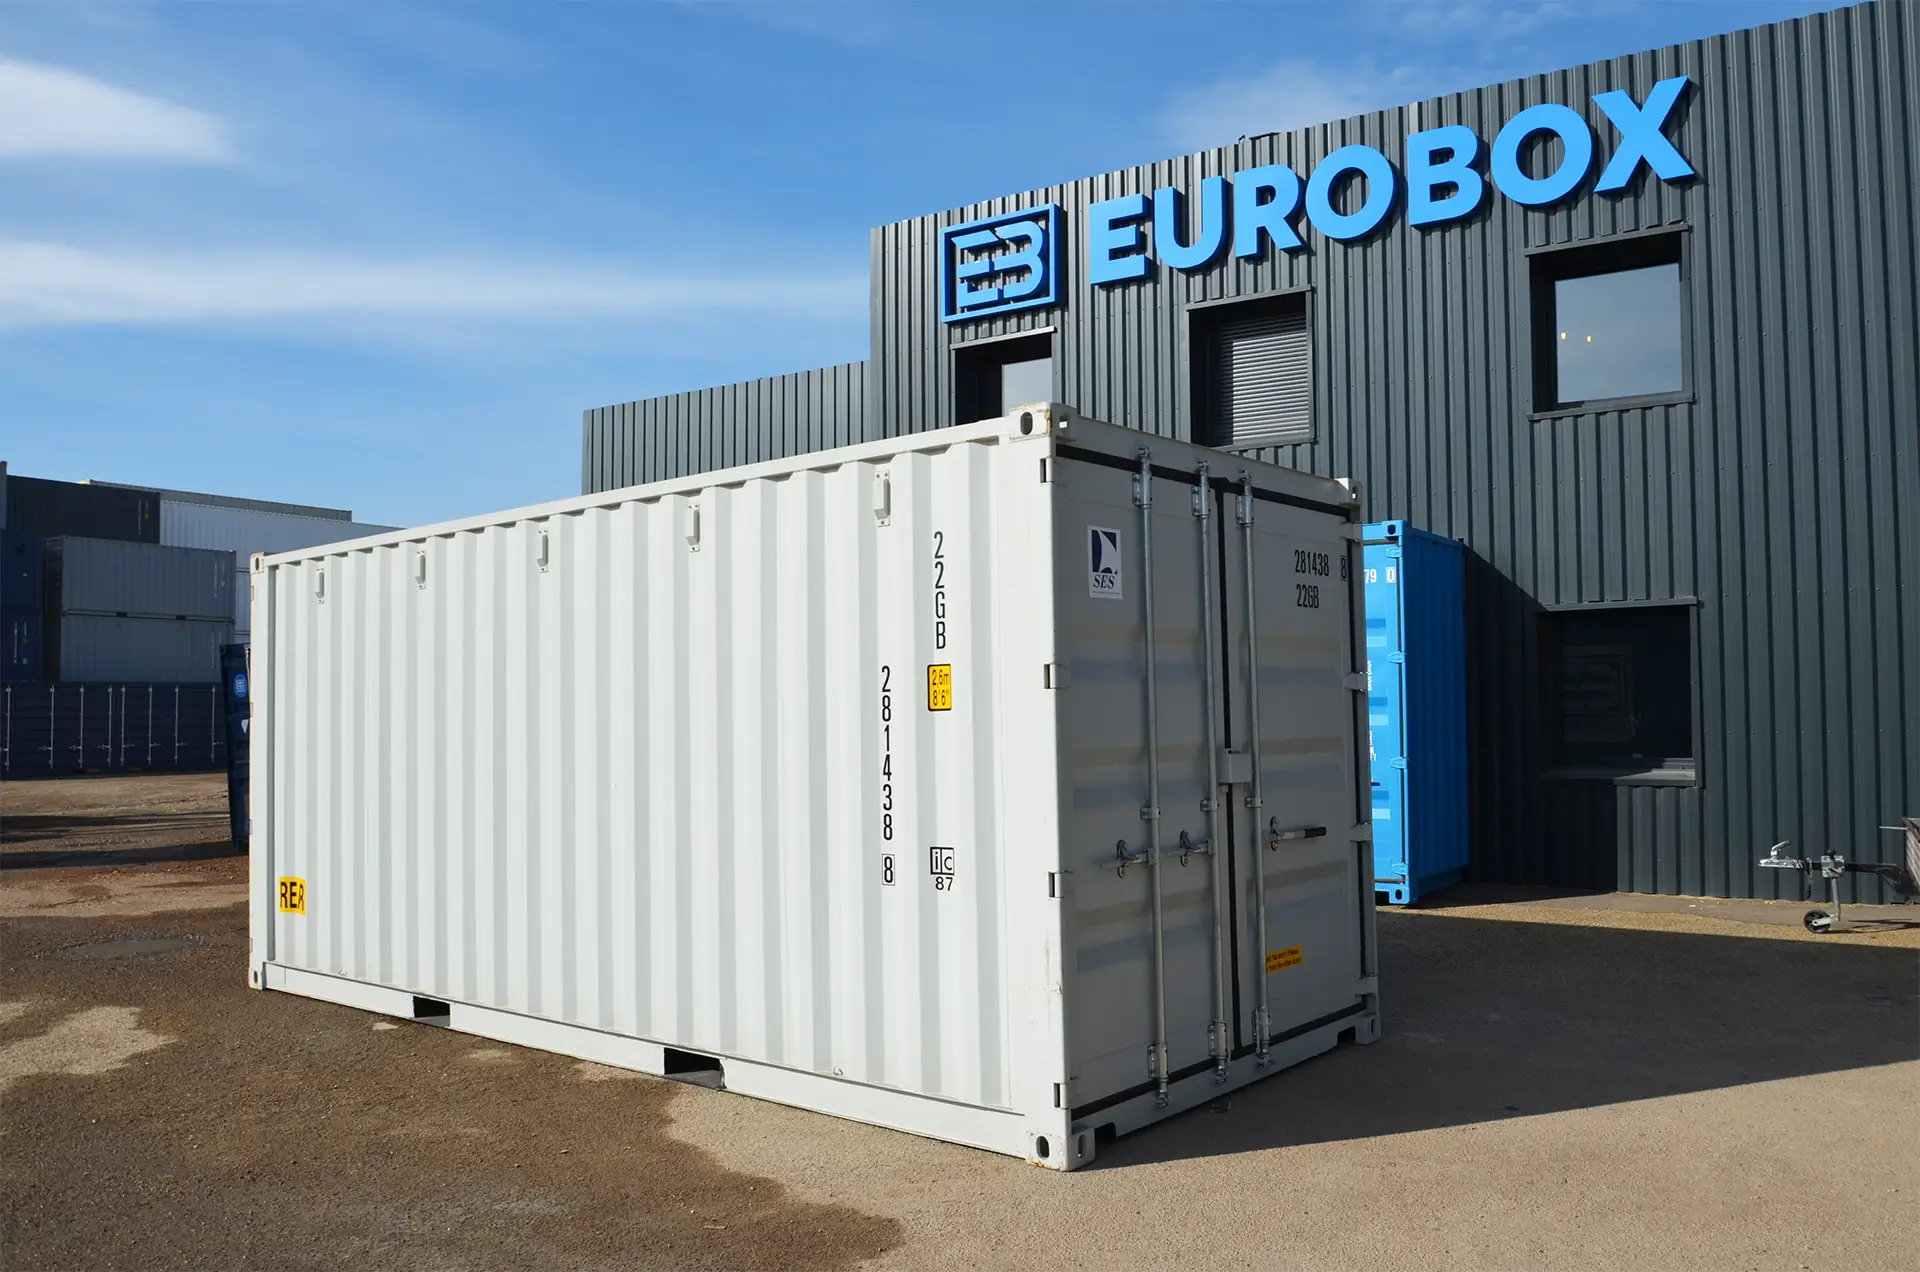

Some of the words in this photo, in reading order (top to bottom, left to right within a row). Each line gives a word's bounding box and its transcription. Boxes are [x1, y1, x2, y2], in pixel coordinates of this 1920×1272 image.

[1089, 75, 1695, 285] EUROBOX
[1294, 549, 1330, 577] 281438
[1340, 556, 1347, 580] 8
[934, 531, 946, 650] 22GB
[1093, 573, 1115, 590] SES
[1296, 584, 1320, 609] 22GB
[881, 665, 893, 841] 281438
[883, 855, 894, 885] 8
[935, 876, 953, 891] 87
